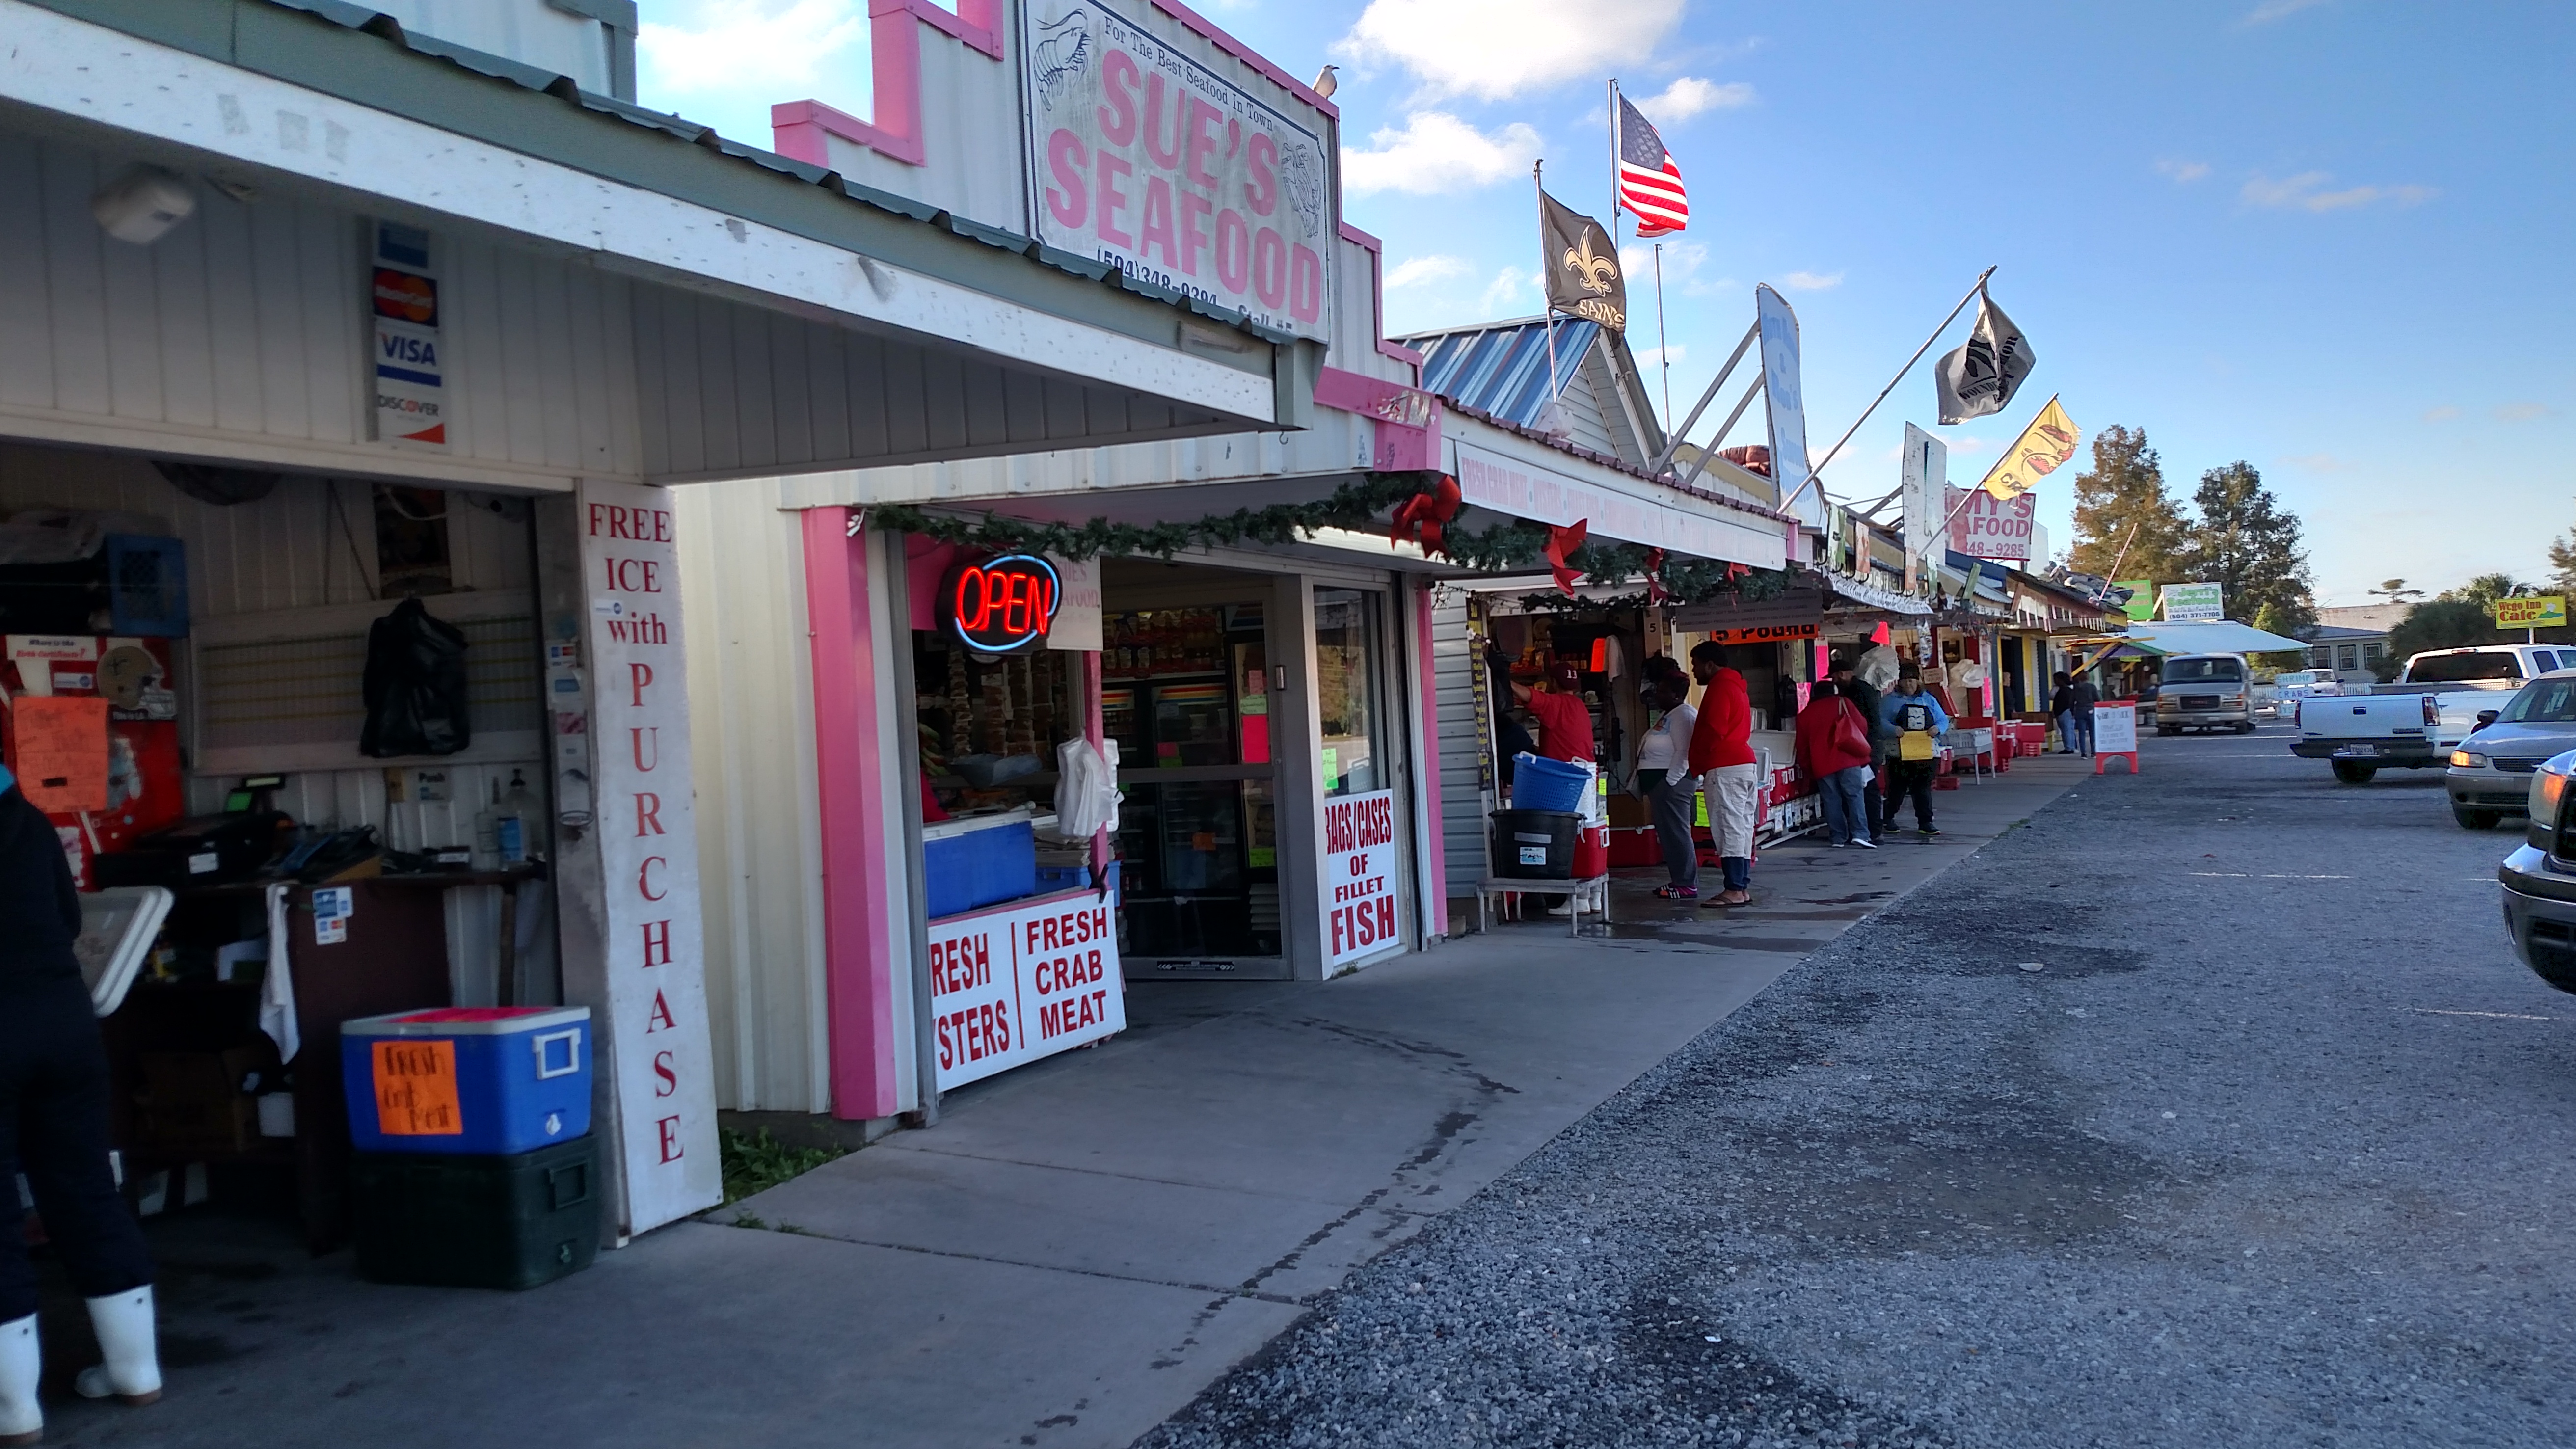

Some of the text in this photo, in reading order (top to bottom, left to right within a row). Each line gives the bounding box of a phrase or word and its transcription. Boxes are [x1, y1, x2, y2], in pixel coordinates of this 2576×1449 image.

[1104, 16, 1273, 131] For The Best Seafood In Town
[1097, 49, 1279, 216] SUE'S
[1046, 128, 1320, 324] SEAFOOD
[379, 331, 437, 366] VISA
[378, 395, 439, 417] DISCOVER
[1958, 381, 1999, 399] WOUNDE
[589, 503, 671, 543] FREE
[1967, 541, 2024, 557] 48-9285
[605, 558, 661, 593] ICE
[957, 566, 1050, 635] OPEN
[2167, 595, 2218, 607] Seafood
[2499, 601, 2541, 612] Wego Inn
[2500, 610, 2536, 621] Cafe
[608, 612, 667, 645] with
[1650, 623, 1656, 633] 5
[1784, 642, 1789, 650] 6
[1566, 669, 1578, 679] 11
[1350, 853, 1368, 877] OF
[1335, 876, 1384, 903] FILLET
[629, 663, 683, 1165] PURCHASE
[1026, 907, 1108, 955] FRESH
[1331, 894, 1395, 956] FISH
[931, 932, 991, 997] RESH
[1035, 949, 1103, 995] CRAB
[1040, 990, 1107, 1041] MEAT
[934, 999, 1010, 1070] STERS
